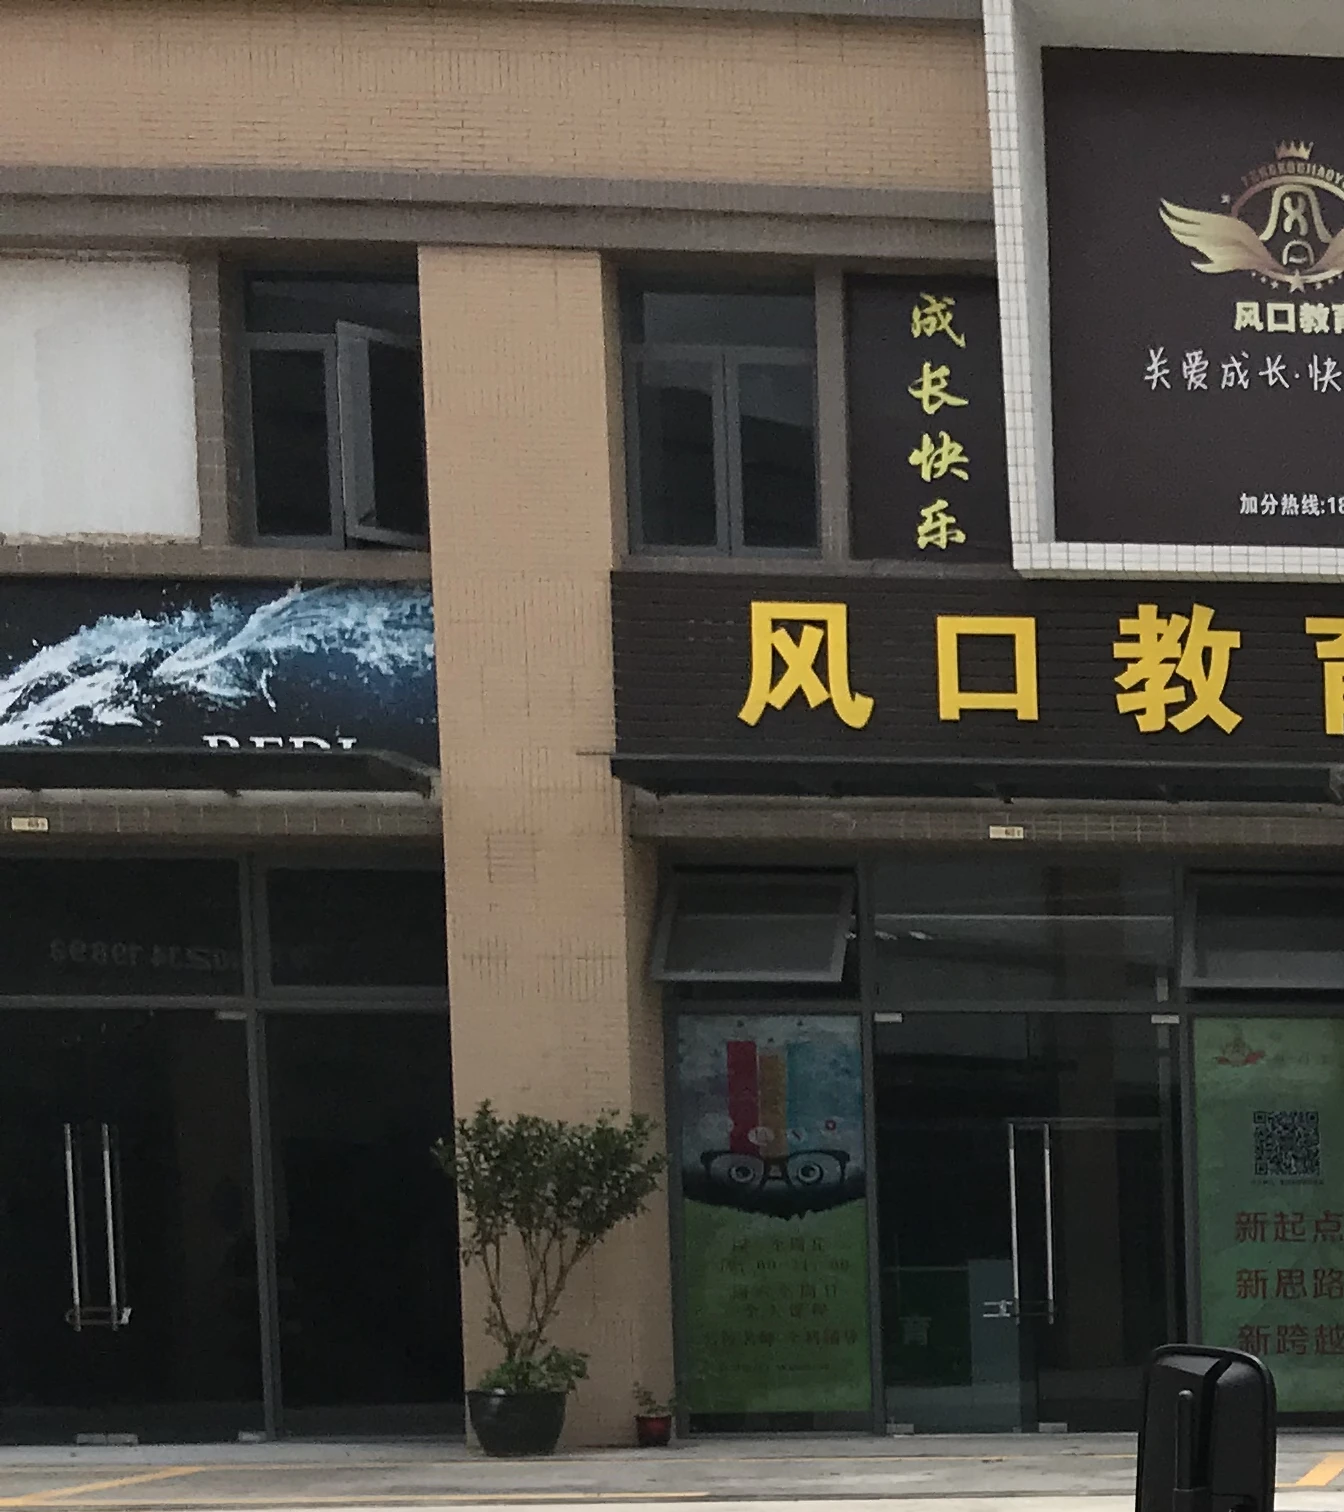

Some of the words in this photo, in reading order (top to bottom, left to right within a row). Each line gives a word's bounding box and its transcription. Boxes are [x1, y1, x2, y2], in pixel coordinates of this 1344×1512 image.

[908, 294, 969, 550] 成长快乐
[1235, 1209, 1344, 1243] 新起点
